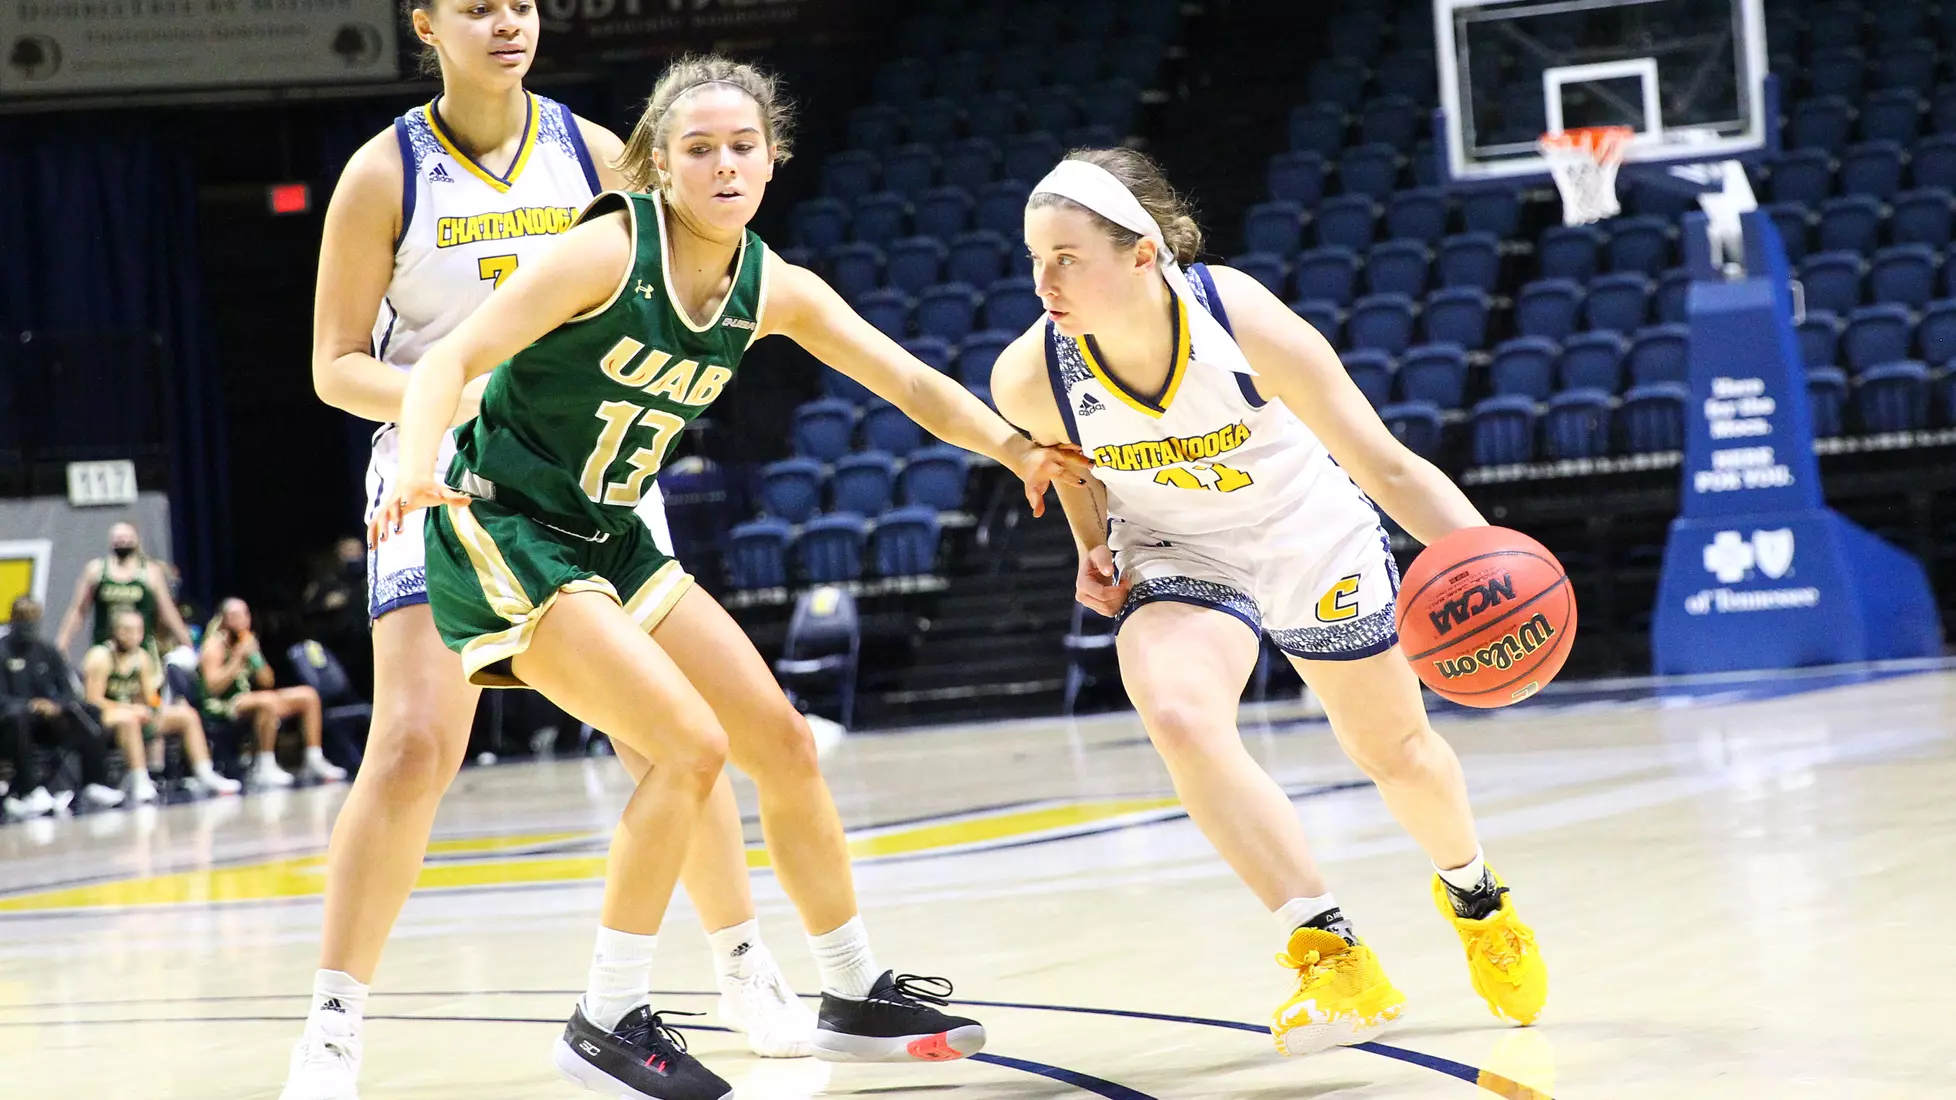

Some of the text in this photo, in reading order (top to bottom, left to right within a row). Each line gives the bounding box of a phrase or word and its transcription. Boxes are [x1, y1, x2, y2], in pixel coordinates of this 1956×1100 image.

[478, 254, 519, 291] 7
[600, 336, 733, 406] UAB
[579, 400, 686, 507] 13
[1315, 573, 1361, 623] C
[1428, 573, 1516, 636] NCAA
[1433, 612, 1555, 680] Wilson
